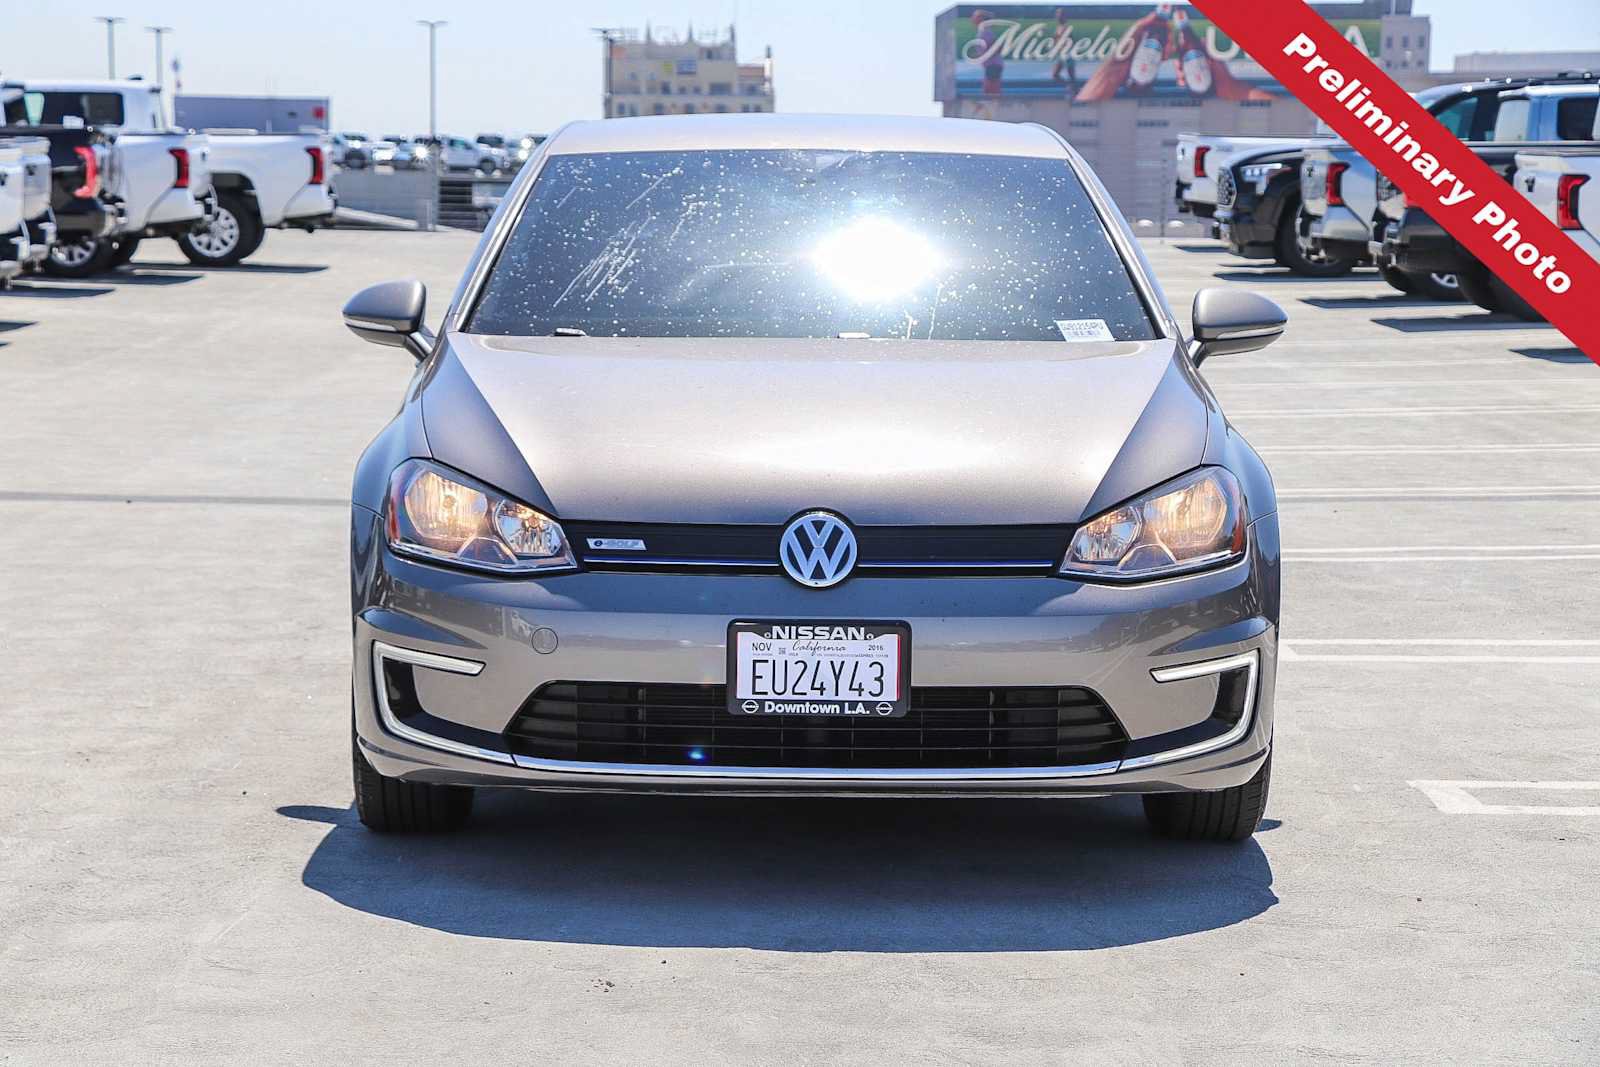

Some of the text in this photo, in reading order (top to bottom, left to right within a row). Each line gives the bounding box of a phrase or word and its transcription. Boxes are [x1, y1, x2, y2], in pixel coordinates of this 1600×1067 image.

[962, 19, 1136, 65] Michelob
[772, 626, 865, 640] NISSAN
[752, 643, 772, 652] NOV
[792, 640, 846, 657] California
[752, 659, 885, 697] EU24Y43
[764, 701, 871, 715] Downtown L.A.
